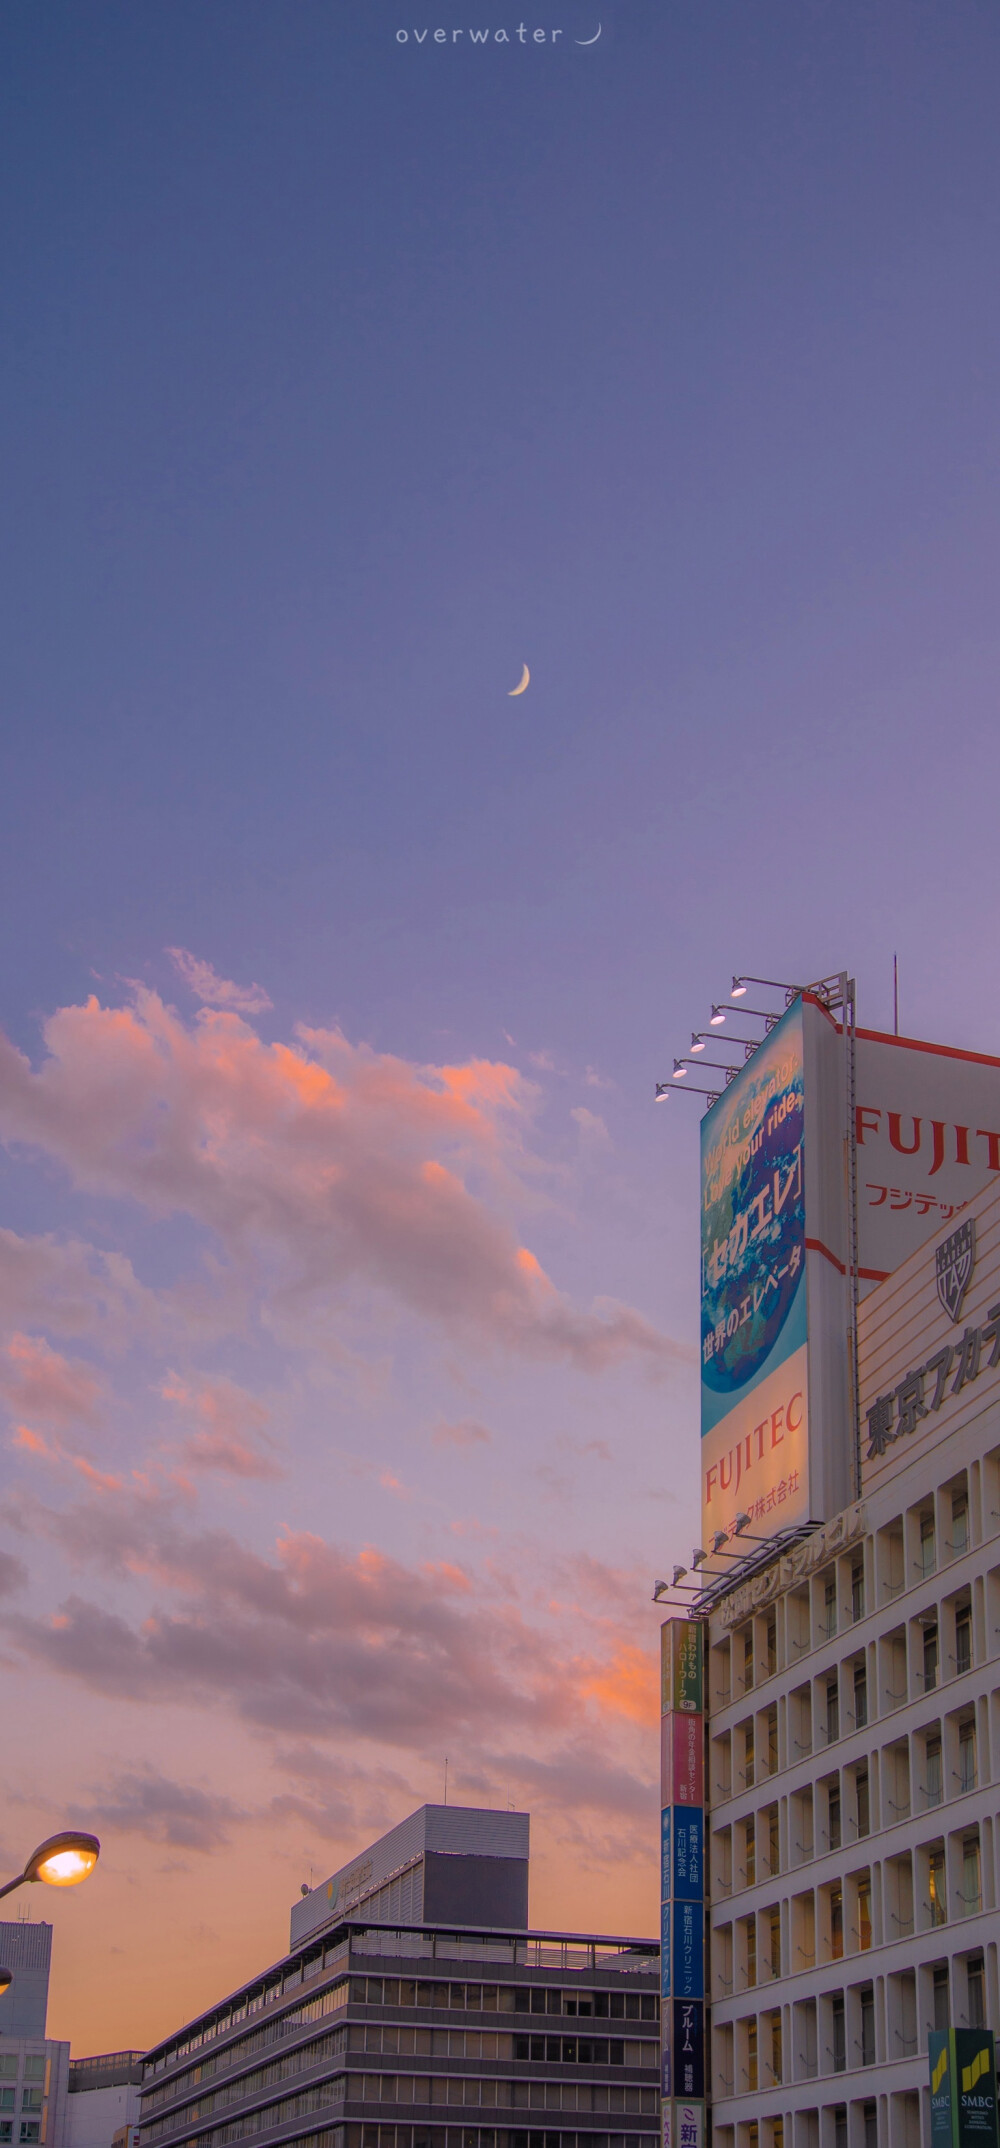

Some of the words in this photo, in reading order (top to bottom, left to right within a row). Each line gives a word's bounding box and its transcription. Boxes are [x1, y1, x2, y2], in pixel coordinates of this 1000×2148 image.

[704, 1118, 740, 1177] World
[743, 1052, 799, 1128] elevator.
[704, 1168, 733, 1212] Love
[736, 1126, 765, 1180] your
[703, 1245, 801, 1365] 世界のエレベータ
[705, 1391, 803, 1505] FUJITEC
[679, 1643, 687, 1698] ハローワーク
[688, 1624, 697, 1680] 新宿わかもの
[682, 1700, 693, 1709] 9F
[677, 1828, 687, 1877] 石川記念会
[689, 1824, 699, 1883] 医療法人社団
[683, 1905, 693, 1994] 新宿石川クリニック
[931, 2096, 950, 2109] SMBC
[961, 2095, 993, 2107] SMBC
[680, 2123, 698, 2148] 新
